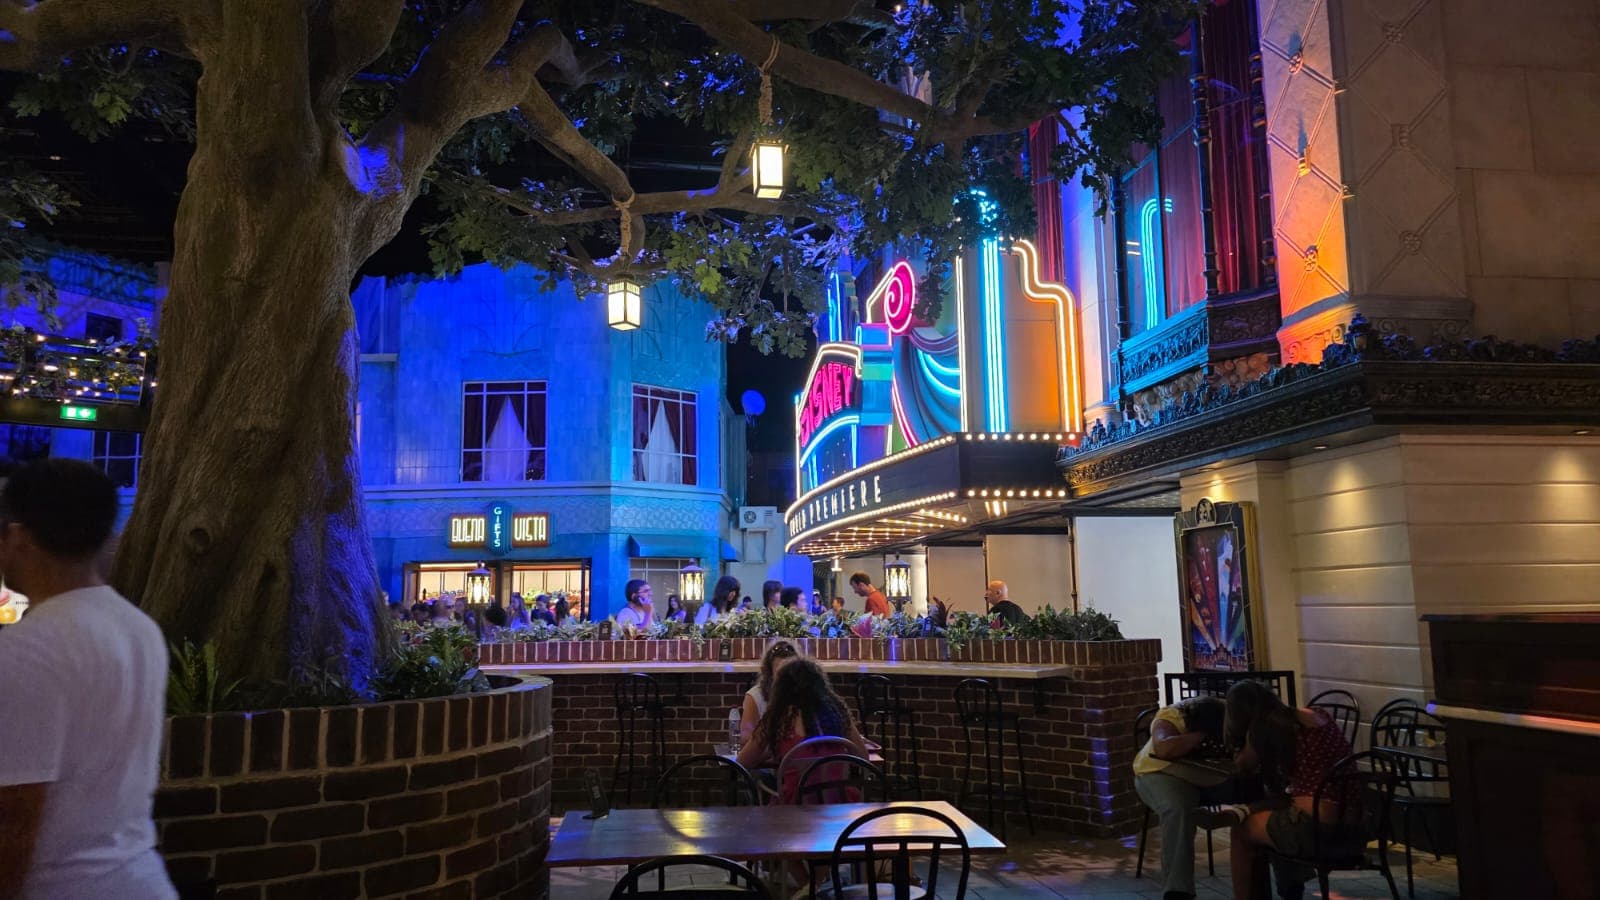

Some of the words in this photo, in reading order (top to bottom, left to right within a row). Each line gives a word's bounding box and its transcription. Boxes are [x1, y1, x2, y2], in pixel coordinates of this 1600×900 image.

[800, 362, 854, 448] DISNEY
[809, 475, 881, 526] PREMIERE
[451, 518, 485, 542] BUENA
[514, 517, 546, 541] VISTA
[493, 506, 503, 547] GIFTS
